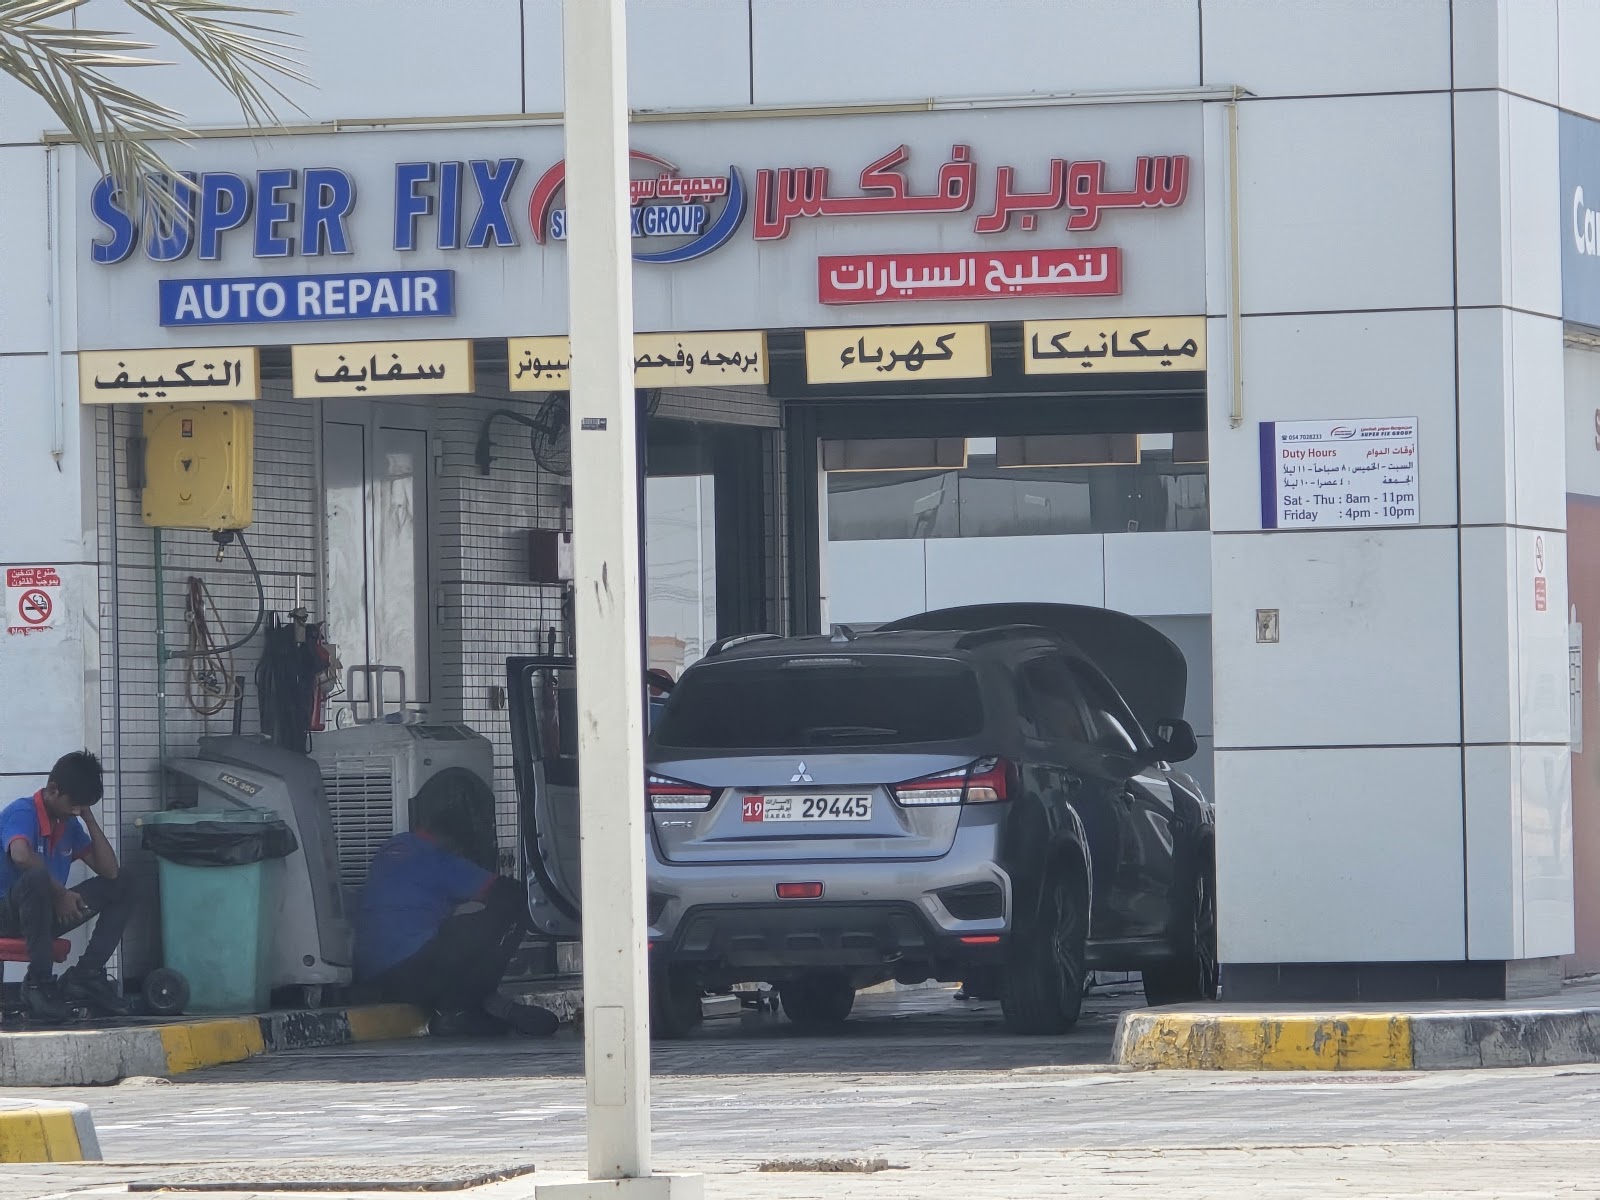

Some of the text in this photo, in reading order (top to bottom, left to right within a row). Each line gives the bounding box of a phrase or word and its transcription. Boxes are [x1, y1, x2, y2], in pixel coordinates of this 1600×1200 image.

[656, 173, 728, 204] مجموعة
[752, 144, 1190, 242] سوبر فكس
[91, 158, 525, 265] SUPER FIX
[644, 205, 706, 235] GROUP
[830, 252, 1109, 296] لتصليح السيارات
[174, 276, 439, 320] AUTO REPAIR
[840, 331, 956, 371] كهرباء
[1032, 329, 1198, 368] ميكانيكا
[94, 359, 243, 398] التكييف
[314, 352, 446, 392] سفايف
[1282, 448, 1337, 460] Duty Hours
[1366, 444, 1415, 459] أوقات الدوام
[1388, 461, 1414, 472] السبت
[1382, 475, 1414, 485] الجمعة
[1283, 495, 1303, 506] Sat
[1313, 494, 1335, 504] Thu
[1345, 493, 1370, 504] 8am
[1382, 492, 1414, 504] 11pm
[1284, 509, 1318, 522] Friday
[1345, 508, 1371, 520] 4pm
[1382, 506, 1415, 519] 10pm
[744, 802, 763, 816] 19
[802, 797, 869, 818] 29445
